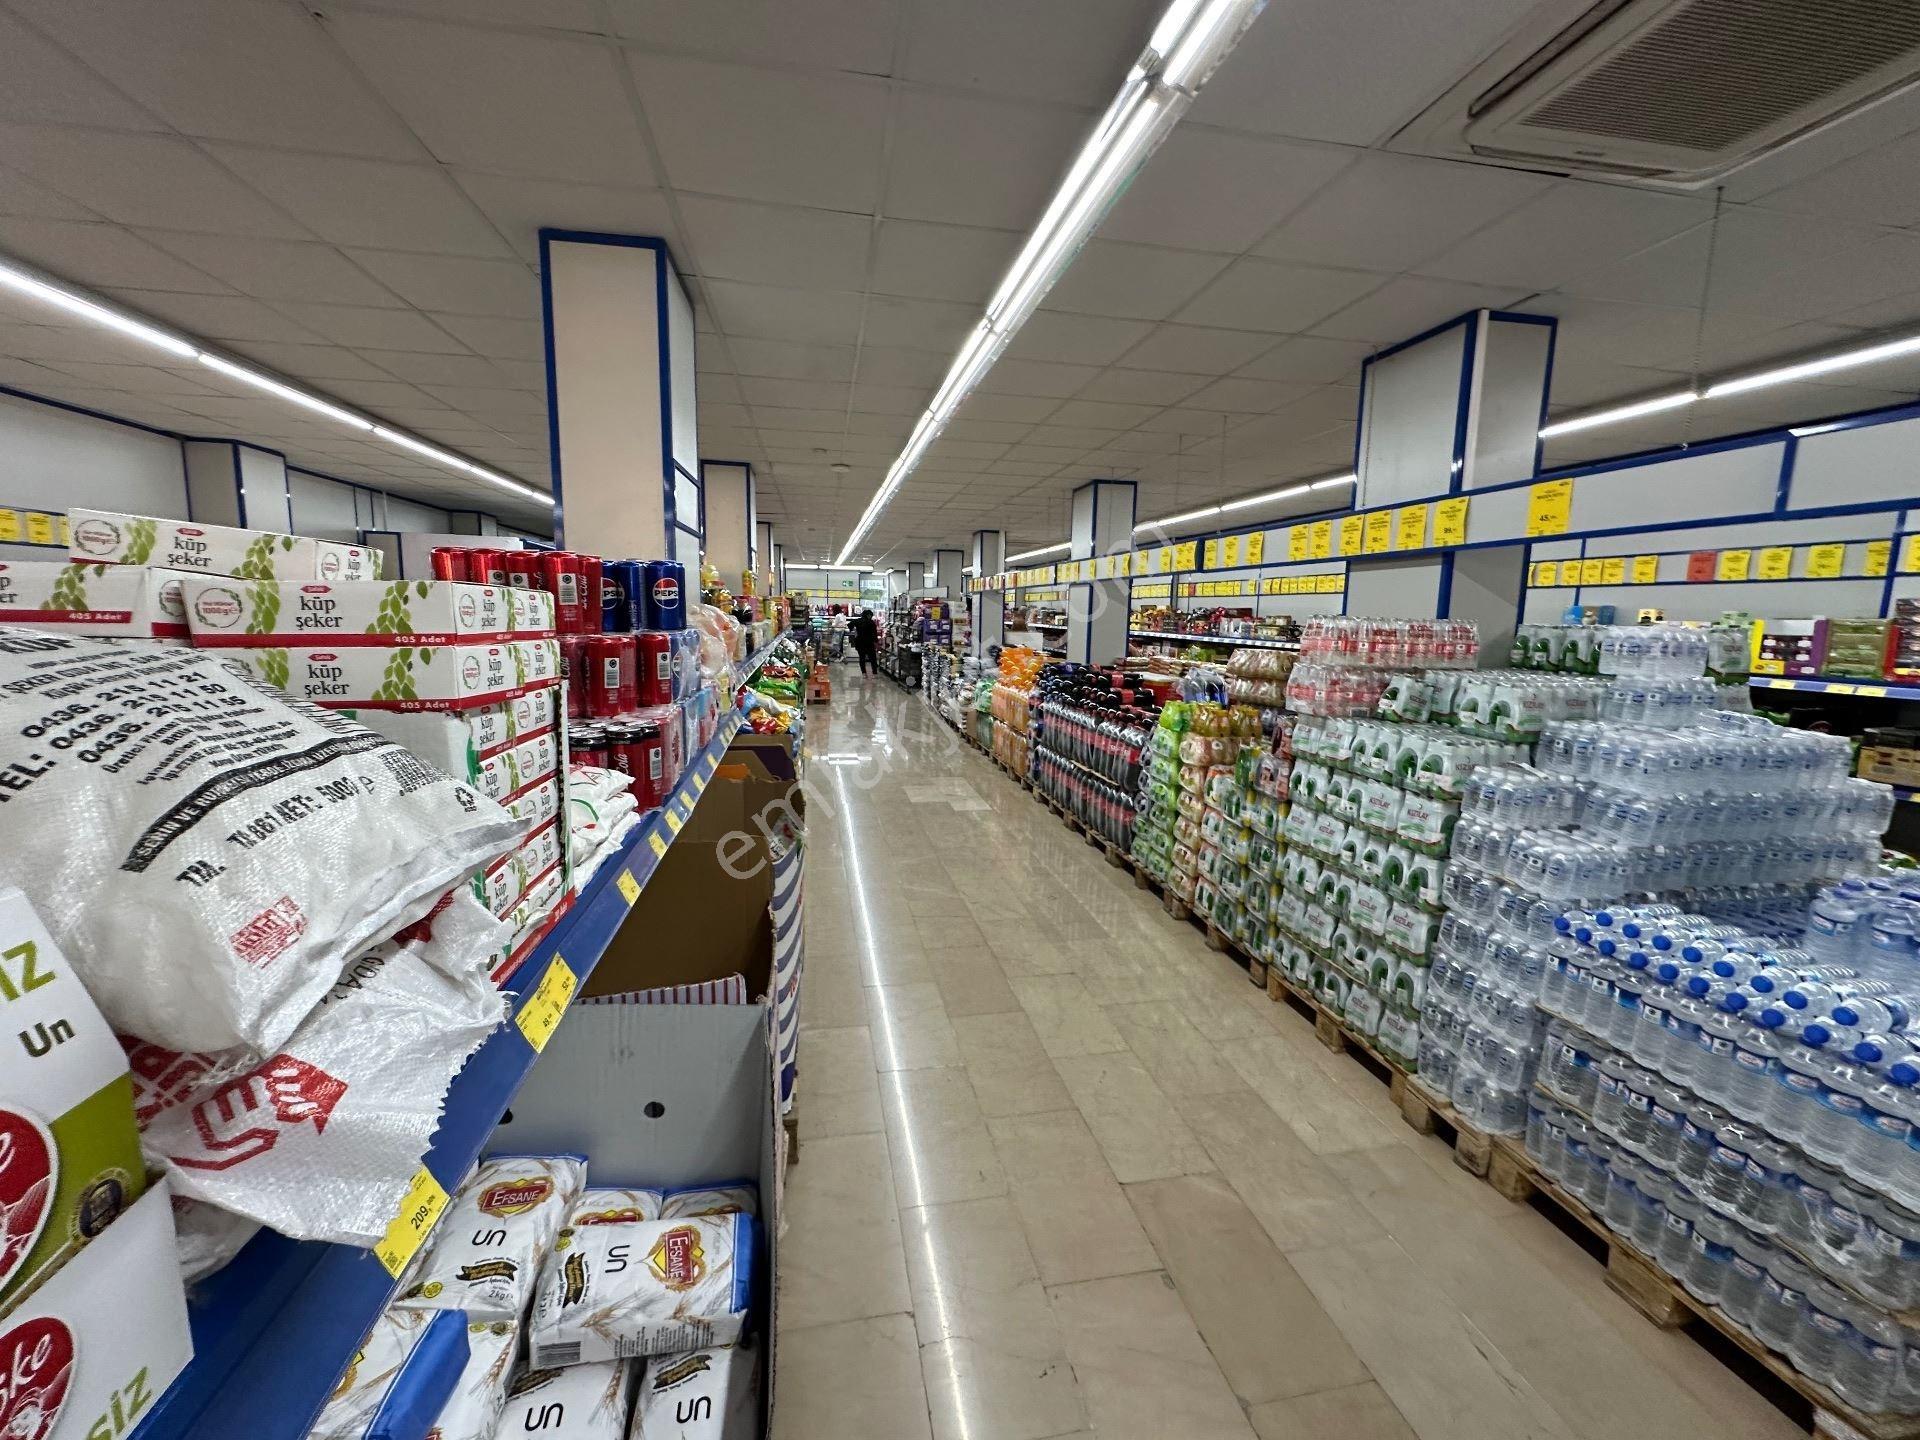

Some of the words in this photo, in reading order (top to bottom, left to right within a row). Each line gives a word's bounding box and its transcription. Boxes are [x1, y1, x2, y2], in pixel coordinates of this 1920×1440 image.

[174, 536, 207, 553] küp
[167, 553, 212, 568] şeker
[300, 596, 336, 615] küp
[296, 614, 343, 631] şeker
[308, 664, 343, 682] küp
[304, 682, 350, 699] şeker
[21, 703, 100, 738] 0436.
[96, 684, 147, 702] 215
[148, 679, 179, 688] 11
[178, 671, 209, 683] 21
[425, 701, 450, 709] Adet
[50, 712, 124, 750] 0436.
[171, 687, 200, 699] 11
[199, 683, 228, 695] 50
[77, 720, 152, 764] 0436.
[147, 702, 193, 719] 215
[192, 700, 218, 711] 11
[218, 695, 247, 707] 55
[174, 804, 201, 822] VE
[272, 794, 323, 825] NET:
[18, 1018, 76, 1058] Un
[492, 1189, 540, 1207] EFSANE
[669, 1236, 690, 1279] EFSANE
